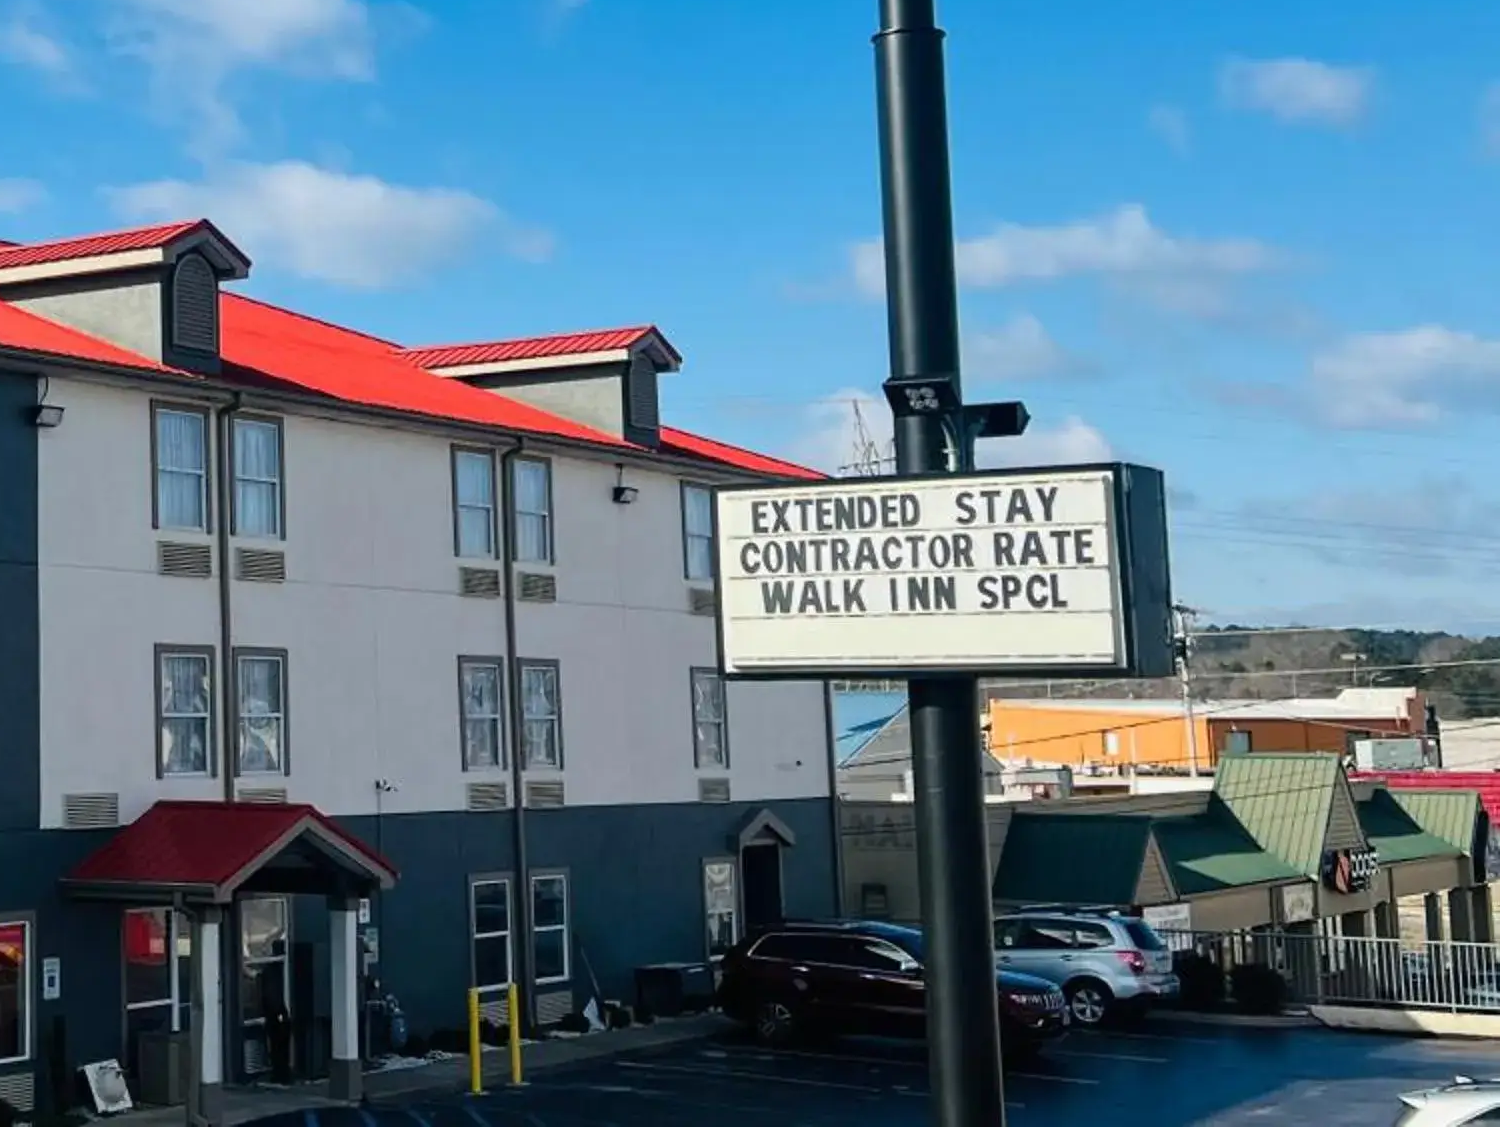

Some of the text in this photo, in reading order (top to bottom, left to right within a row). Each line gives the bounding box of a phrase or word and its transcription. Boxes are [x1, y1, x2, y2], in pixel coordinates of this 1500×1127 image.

[751, 486, 1059, 534] EXTENDED STAY
[740, 528, 1095, 574] CONTRACTOR RATE
[761, 573, 1068, 614] WALK INN SPCL
